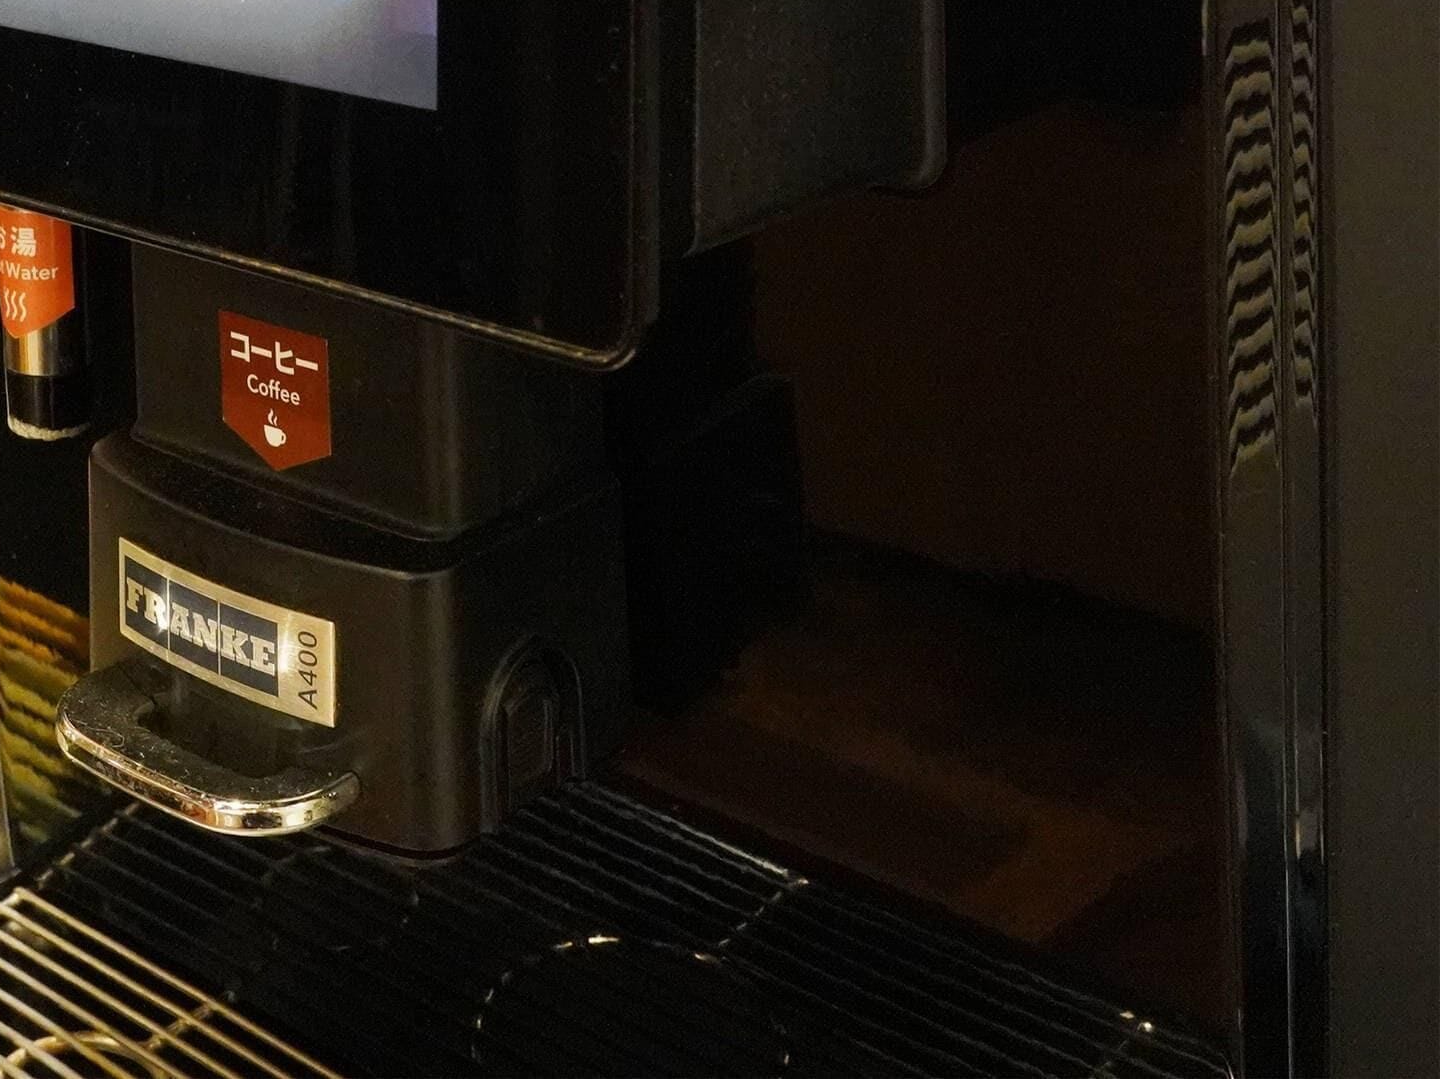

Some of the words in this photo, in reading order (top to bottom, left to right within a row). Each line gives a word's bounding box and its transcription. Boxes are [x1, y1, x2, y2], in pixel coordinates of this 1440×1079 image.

[5, 259, 59, 281] Water
[229, 329, 320, 373] コーヒー
[246, 373, 301, 408] Coffee
[125, 575, 277, 676] FRANKE
[296, 630, 319, 711] A400
